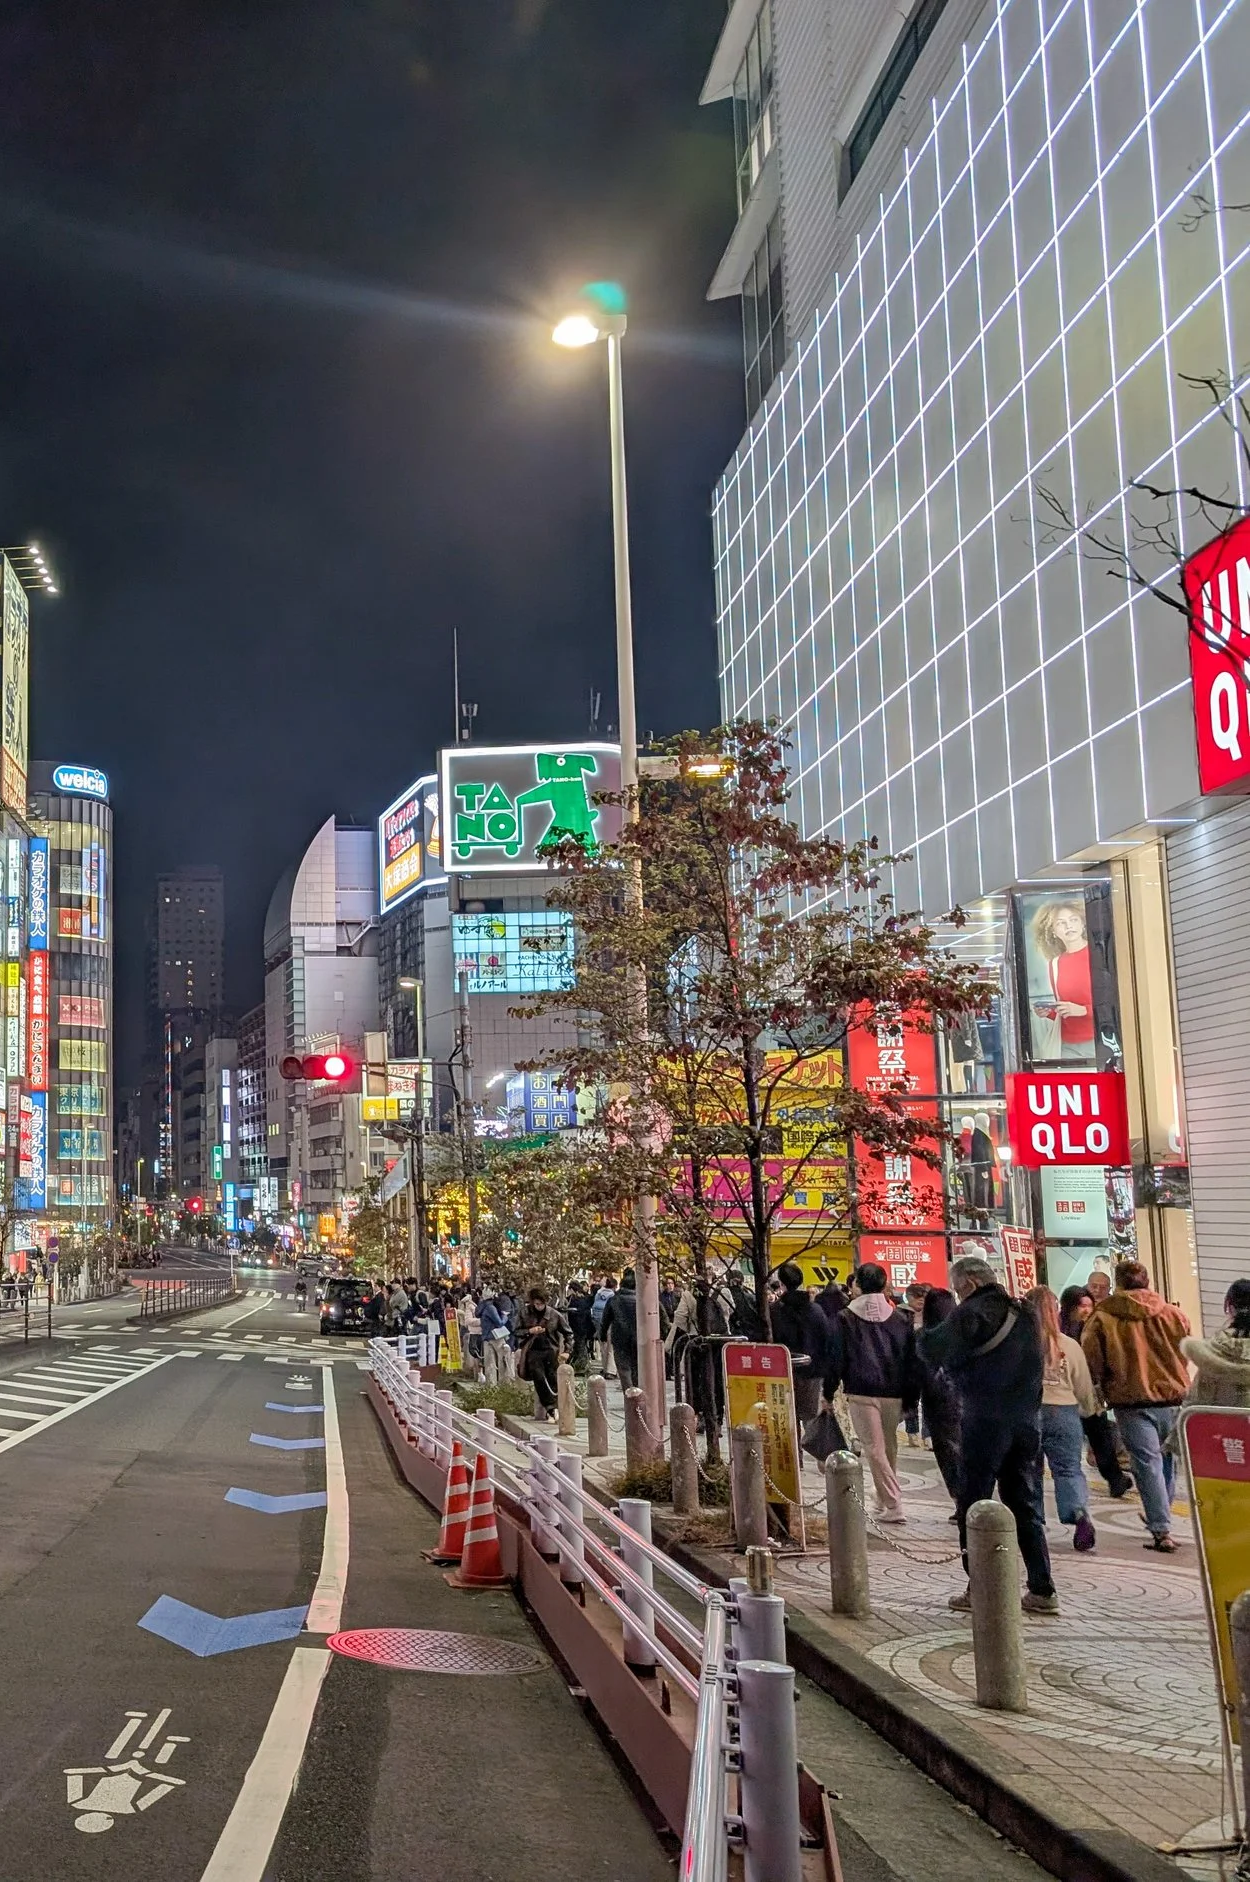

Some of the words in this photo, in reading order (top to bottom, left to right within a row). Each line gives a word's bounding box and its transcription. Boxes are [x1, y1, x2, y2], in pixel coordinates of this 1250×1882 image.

[58, 770, 105, 794] welcia
[385, 852, 418, 893] 大塚商会
[31, 851, 46, 937] カラオケの鉄人
[1027, 1084, 1100, 1116] UNI
[31, 1104, 44, 1196] カラオケの鉄人
[1031, 1122, 1110, 1160] QLO
[891, 1262, 918, 1288] 感
[741, 1355, 772, 1369] 警告
